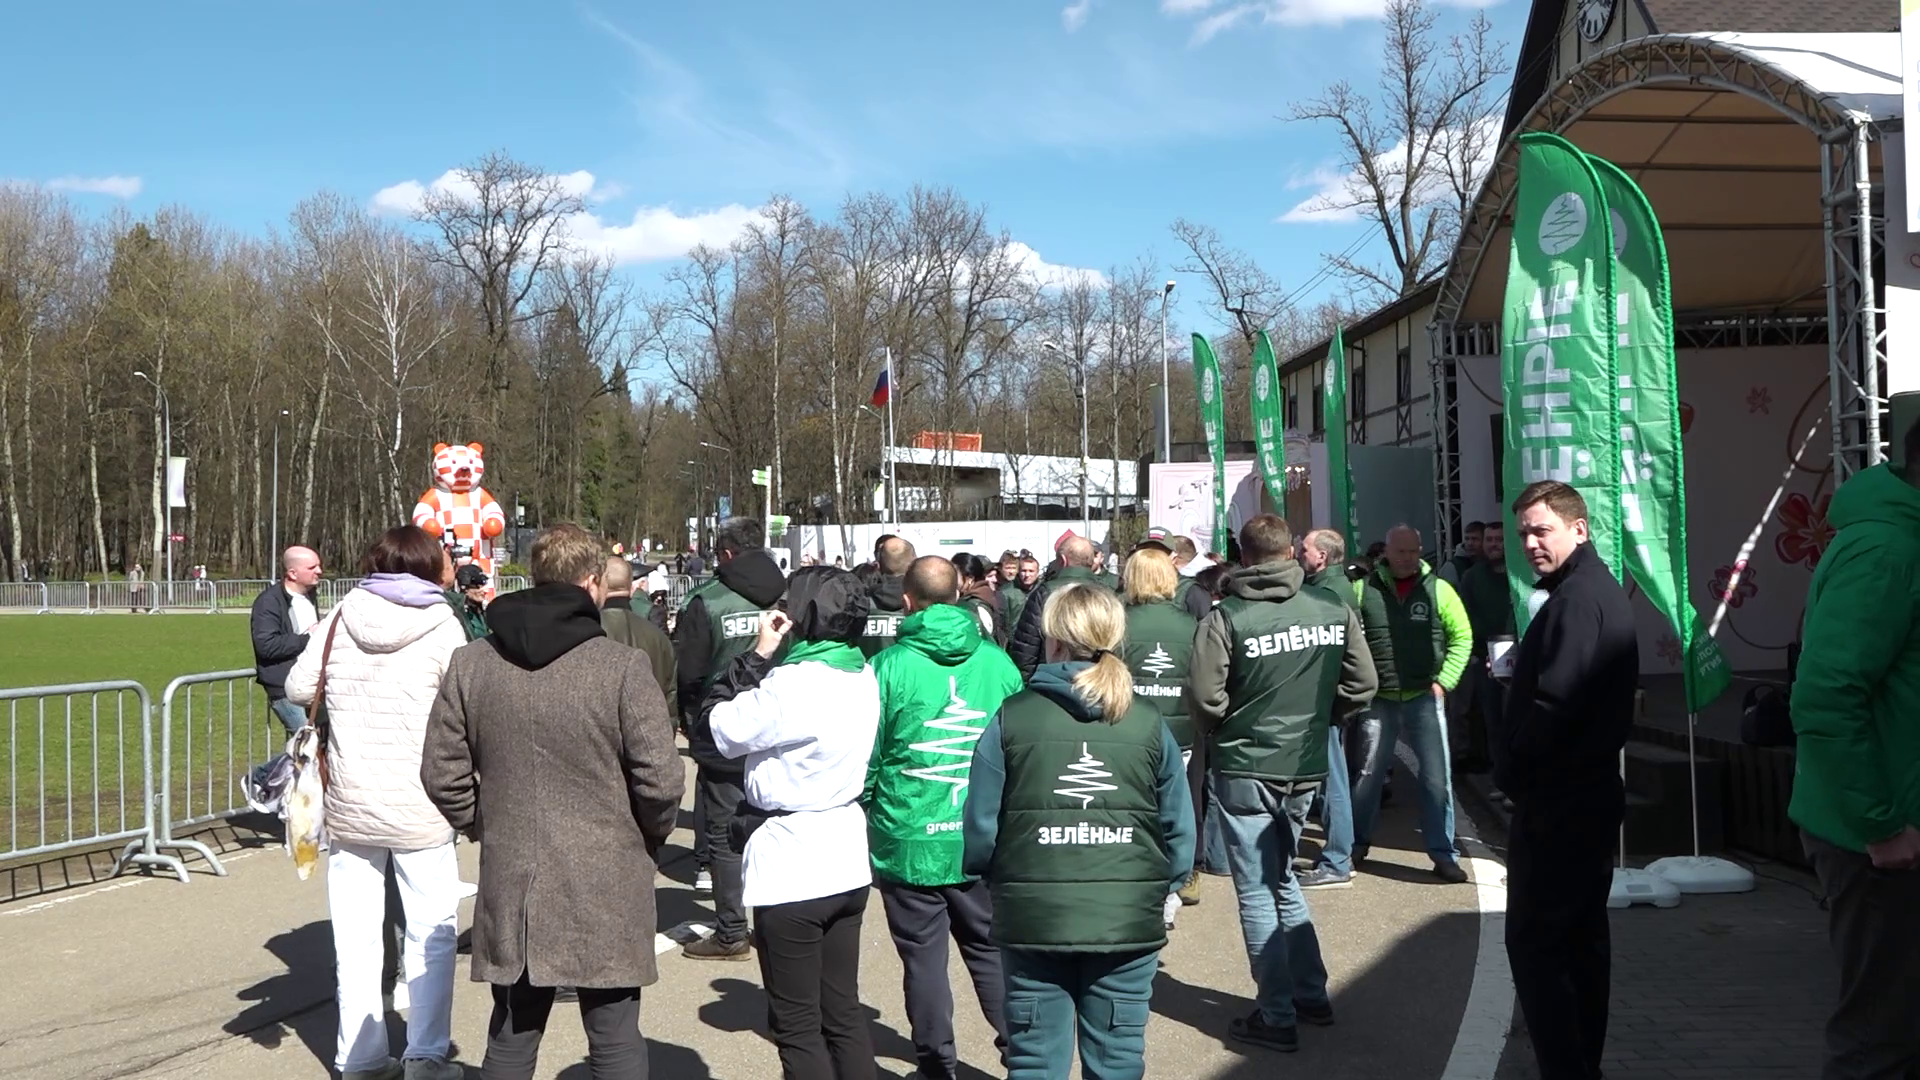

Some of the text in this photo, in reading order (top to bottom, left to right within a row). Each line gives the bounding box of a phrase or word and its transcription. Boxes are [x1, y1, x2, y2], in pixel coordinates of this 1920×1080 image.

[723, 616, 760, 636] ЗЕЛ
[1244, 624, 1345, 659] ЗЕЛЁНЫЕ
[1037, 822, 1134, 845] ЗЕЛЁНЫЕ
